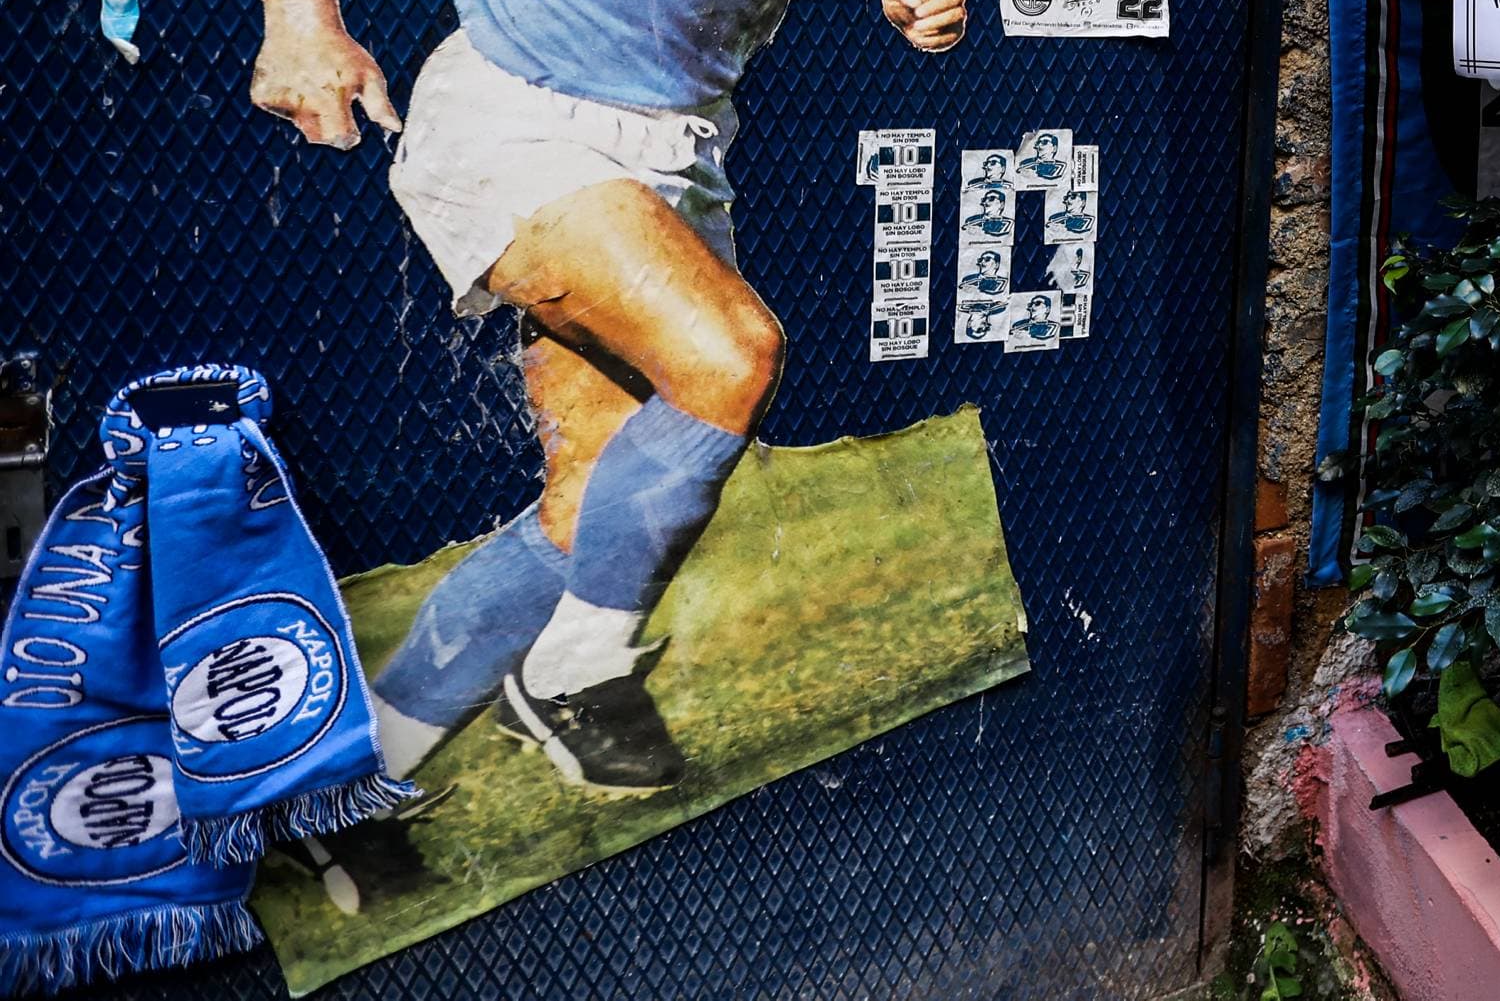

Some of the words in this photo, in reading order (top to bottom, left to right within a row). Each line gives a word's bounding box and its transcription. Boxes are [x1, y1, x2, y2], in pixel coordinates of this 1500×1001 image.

[893, 145, 919, 167] 10
[891, 202, 918, 224] 10
[889, 259, 915, 281] 10
[887, 317, 913, 340] 10
[24, 543, 118, 625] UNA
[3, 636, 87, 709] DIO
[206, 638, 284, 741] NAPOLI
[276, 620, 334, 726] NAPOLI
[13, 761, 80, 860] NAPOLI
